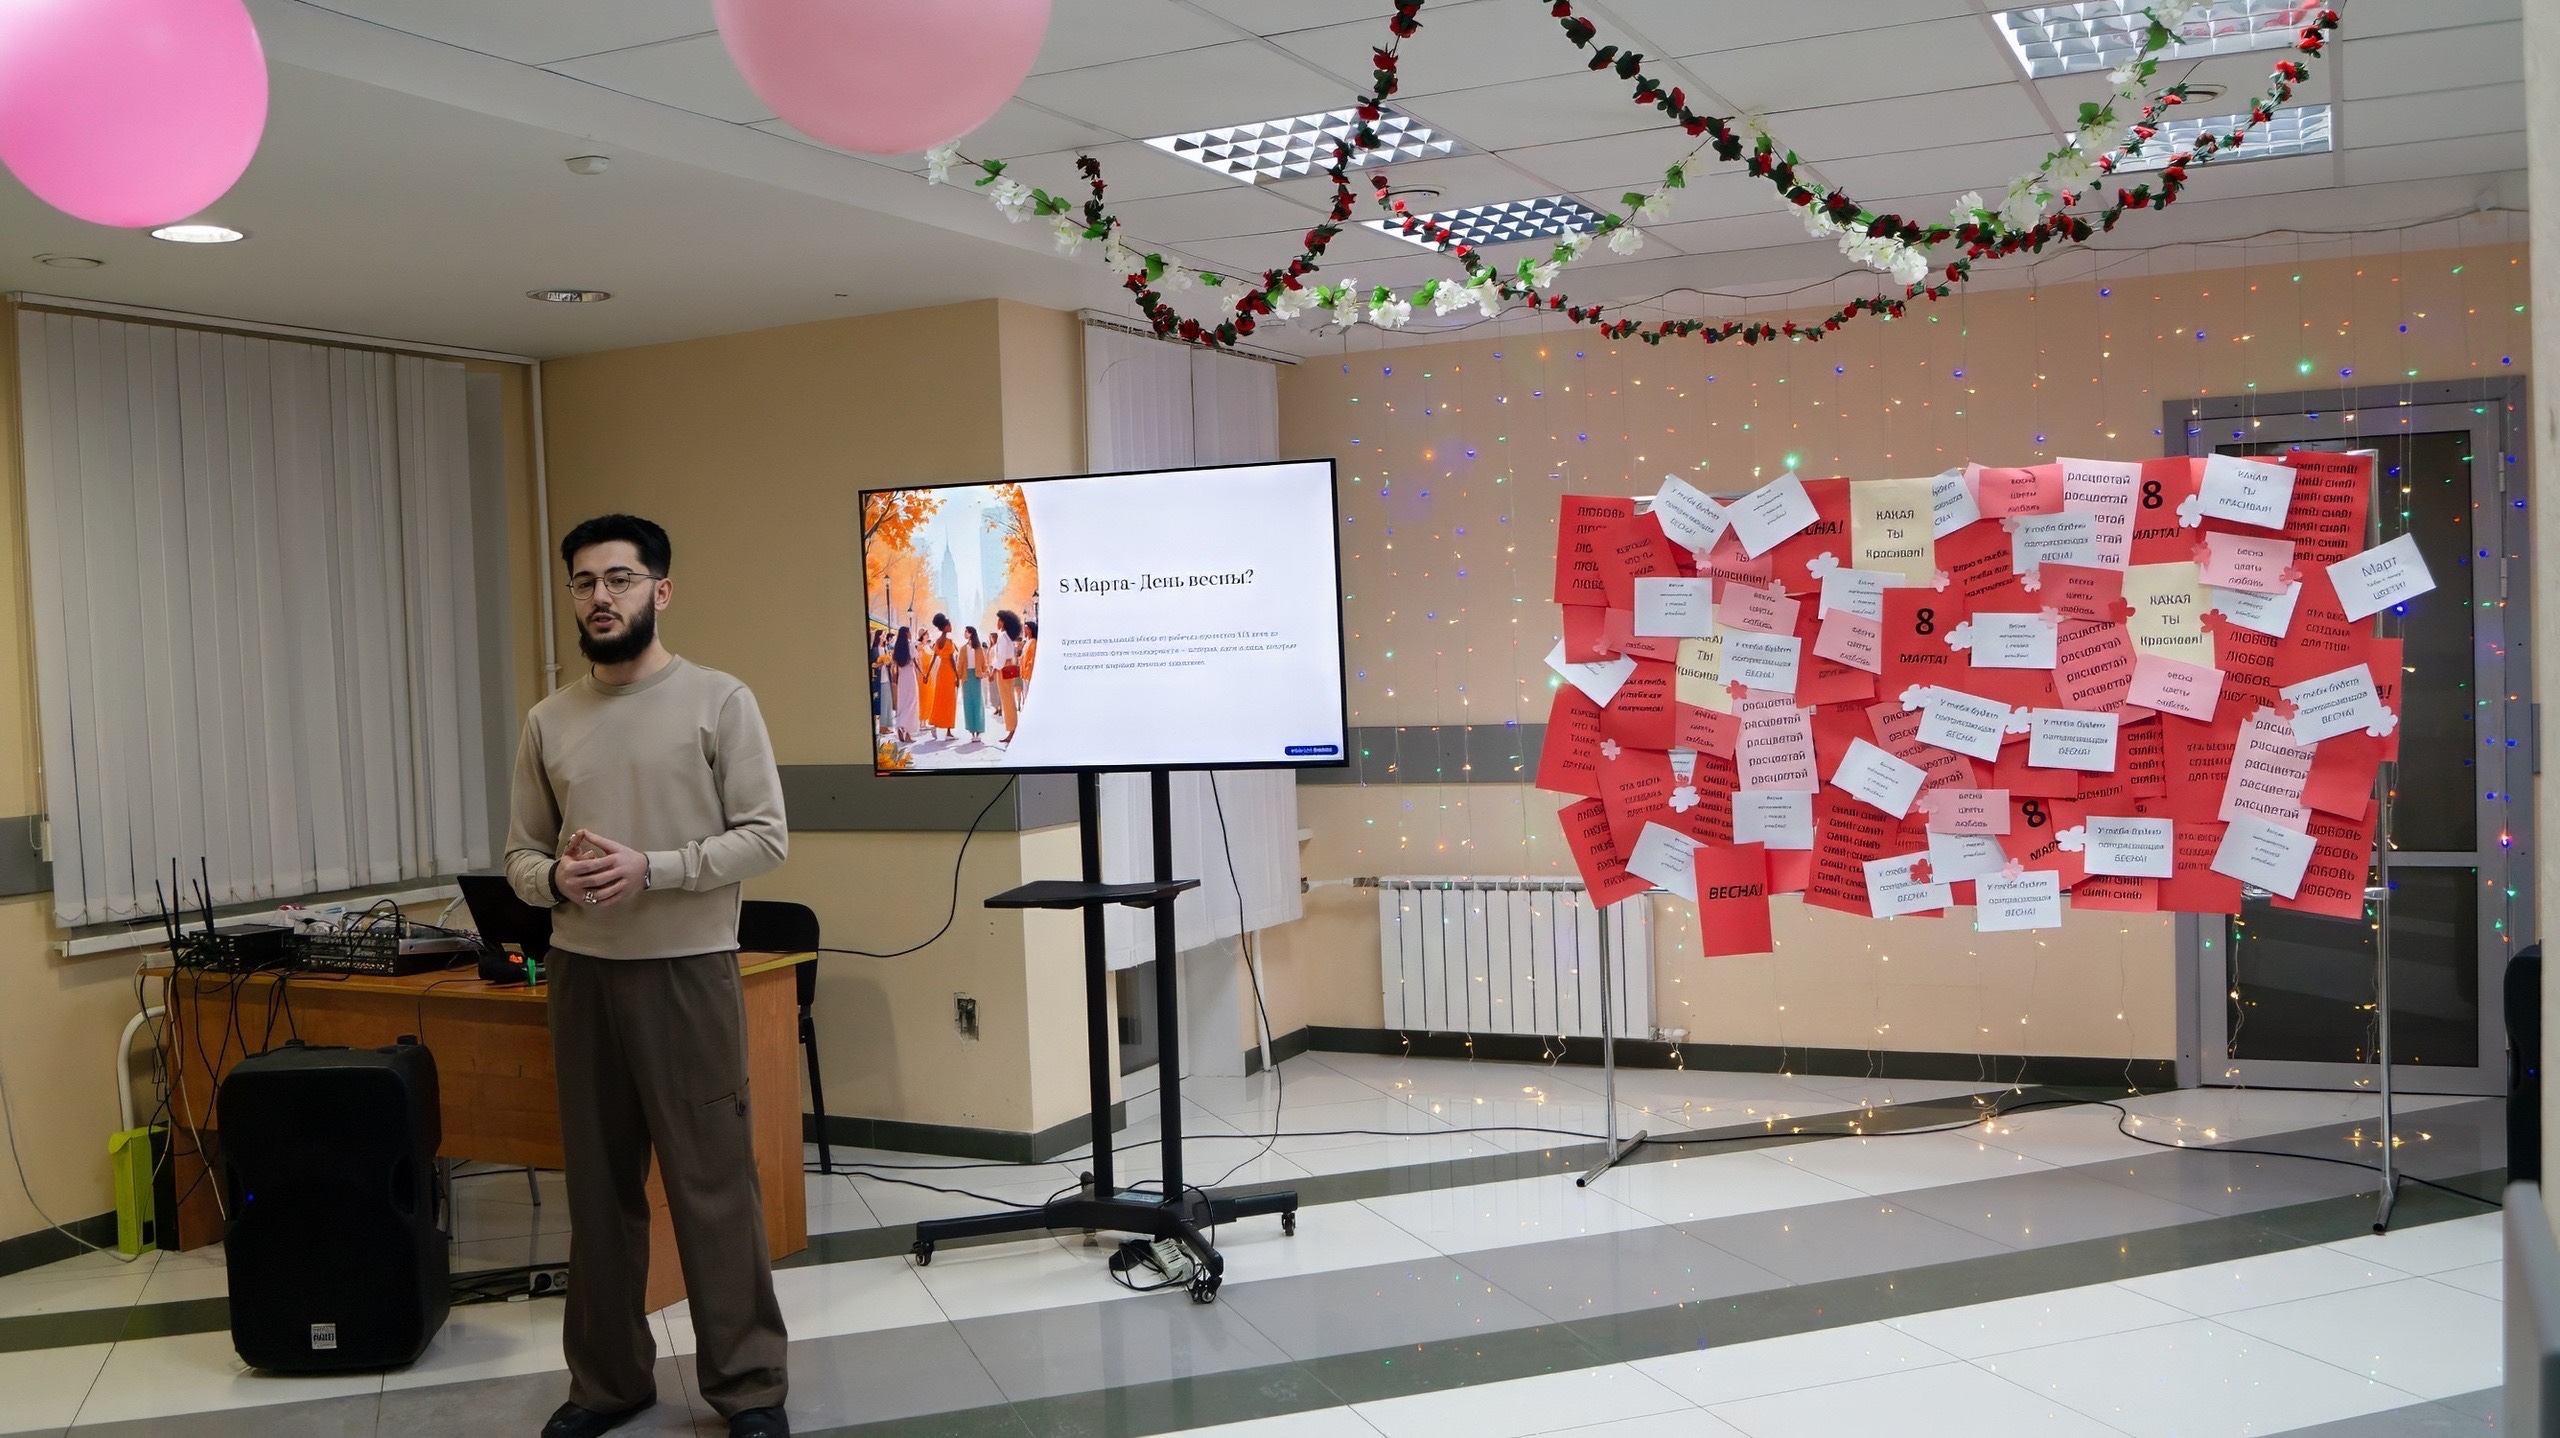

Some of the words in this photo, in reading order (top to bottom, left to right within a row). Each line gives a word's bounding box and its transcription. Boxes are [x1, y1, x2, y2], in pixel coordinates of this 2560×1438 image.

[2067, 472, 2131, 485] расцветай
[2065, 491, 2128, 504] расцветай
[2142, 481, 2163, 509] 8
[1876, 510, 1914, 520] КАКАЯ
[1887, 529, 1904, 538] ТЫ
[1866, 548, 1924, 559] Красивая!
[2361, 556, 2397, 577] Март
[1140, 574, 1184, 591] День
[1189, 569, 1254, 587] весны?
[2150, 594, 2191, 605] КАКАЯ
[1915, 608, 1934, 635] 8
[2162, 614, 2180, 625] ТЫ
[2140, 635, 2202, 647] Красивая!
[2230, 632, 2278, 647] ЛЮБОВ
[1698, 650, 1713, 661] ТЫ
[1900, 653, 1948, 665] МАРТА!
[2226, 651, 2274, 667] ЛЮБОВ
[2225, 671, 2270, 686] ЛЮБОВ
[1747, 732, 1804, 748] расцветай
[1749, 751, 1806, 767] расцветай
[1751, 769, 1808, 785] расцветай
[2022, 800, 2046, 827] 8
[2234, 798, 2300, 819] расцветай
[2030, 841, 2062, 861] МАР
[1709, 884, 1763, 899] ВЕСНА!
